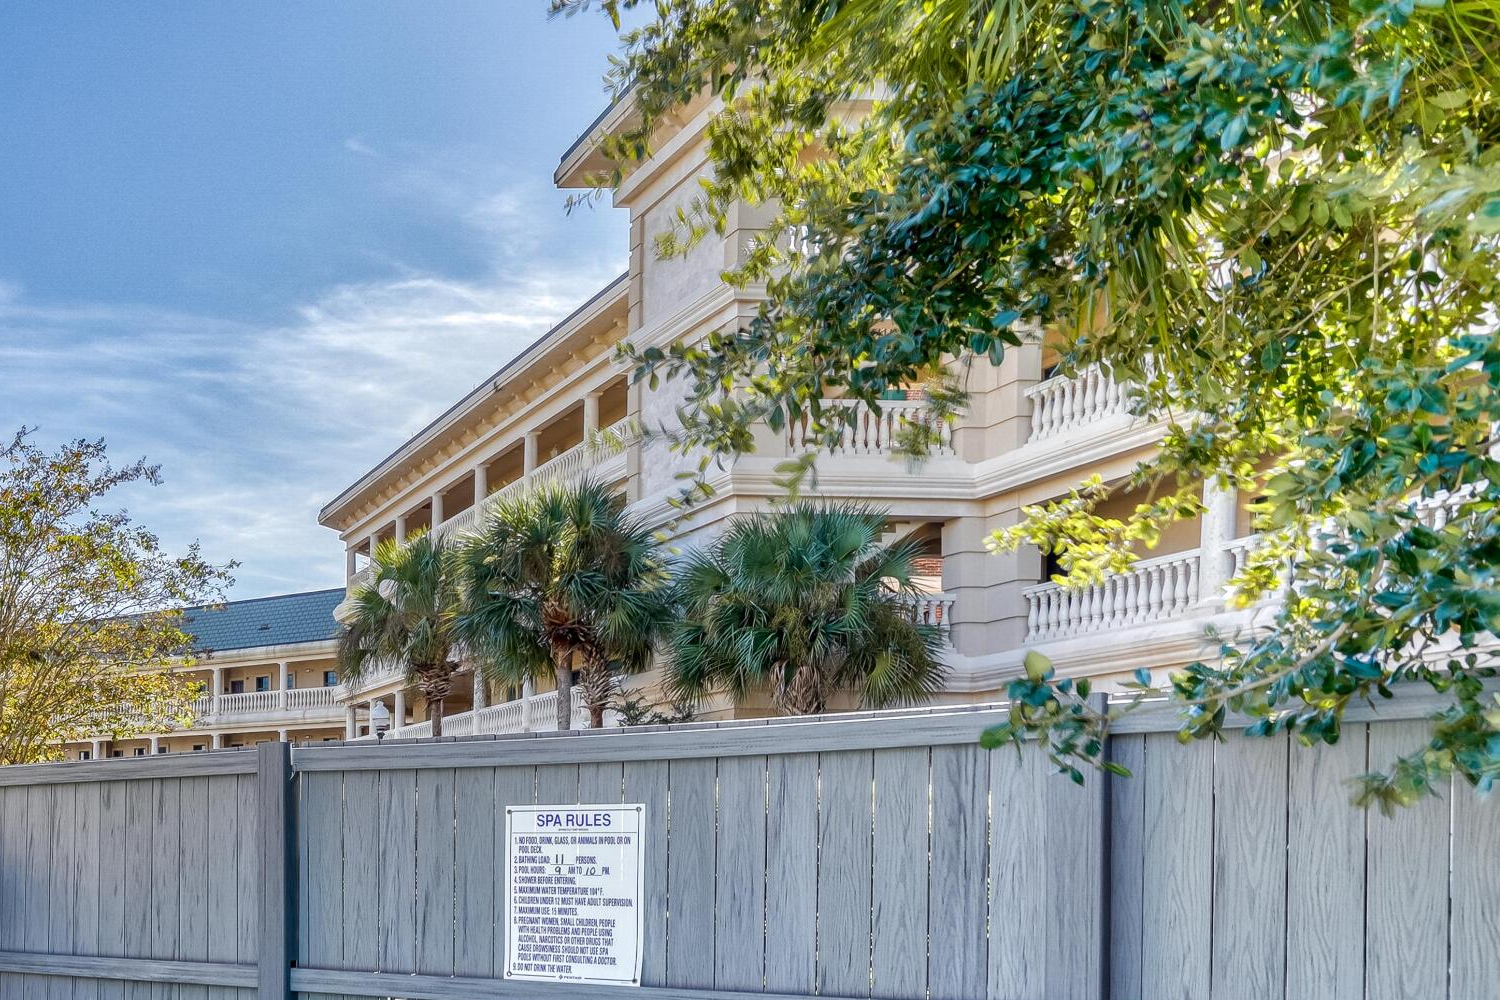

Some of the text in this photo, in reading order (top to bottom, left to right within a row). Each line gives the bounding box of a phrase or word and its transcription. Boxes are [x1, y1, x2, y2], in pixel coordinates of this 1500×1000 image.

[537, 814, 611, 827] SPA RULES
[539, 837, 553, 845] DRINK,
[555, 837, 569, 845] GLASS,
[578, 836, 597, 844] ANIMALS
[604, 836, 616, 844] POOL
[555, 866, 561, 875] 9
[586, 866, 596, 875] 10
[519, 876, 536, 884] SHOWER
[538, 876, 553, 884] BEFORE
[519, 886, 540, 894] MAXIMUM
[541, 886, 556, 894] WATER
[557, 887, 588, 895] TEMPERATURE
[519, 896, 539, 904] CHILDREN
[540, 897, 554, 905] UNDER
[561, 897, 573, 905] MUST
[575, 897, 586, 906] HAVE
[587, 898, 601, 906] ADULT
[519, 906, 540, 914] MAXIMUM
[519, 916, 540, 924] PREGNANT
[560, 917, 574, 926] SMALL
[599, 919, 615, 927] PEOPLE
[518, 925, 612, 937] WITH HEALTH PROBLEMS AND PEOPLE USING
[539, 936, 563, 944] NARCOTICS
[571, 937, 585, 945] OTHER
[586, 937, 601, 946] DRUGS
[602, 938, 614, 946] THAT
[518, 943, 608, 955] CAUSE DROWSINESS SHOULD NOT USE SPA
[518, 952, 531, 961] POOLS
[532, 953, 551, 962] WITHOUT
[553, 954, 564, 962] FIRST
[566, 955, 593, 964] CONSULTING
[524, 963, 533, 971] NOT
[534, 964, 546, 972] DRINK
